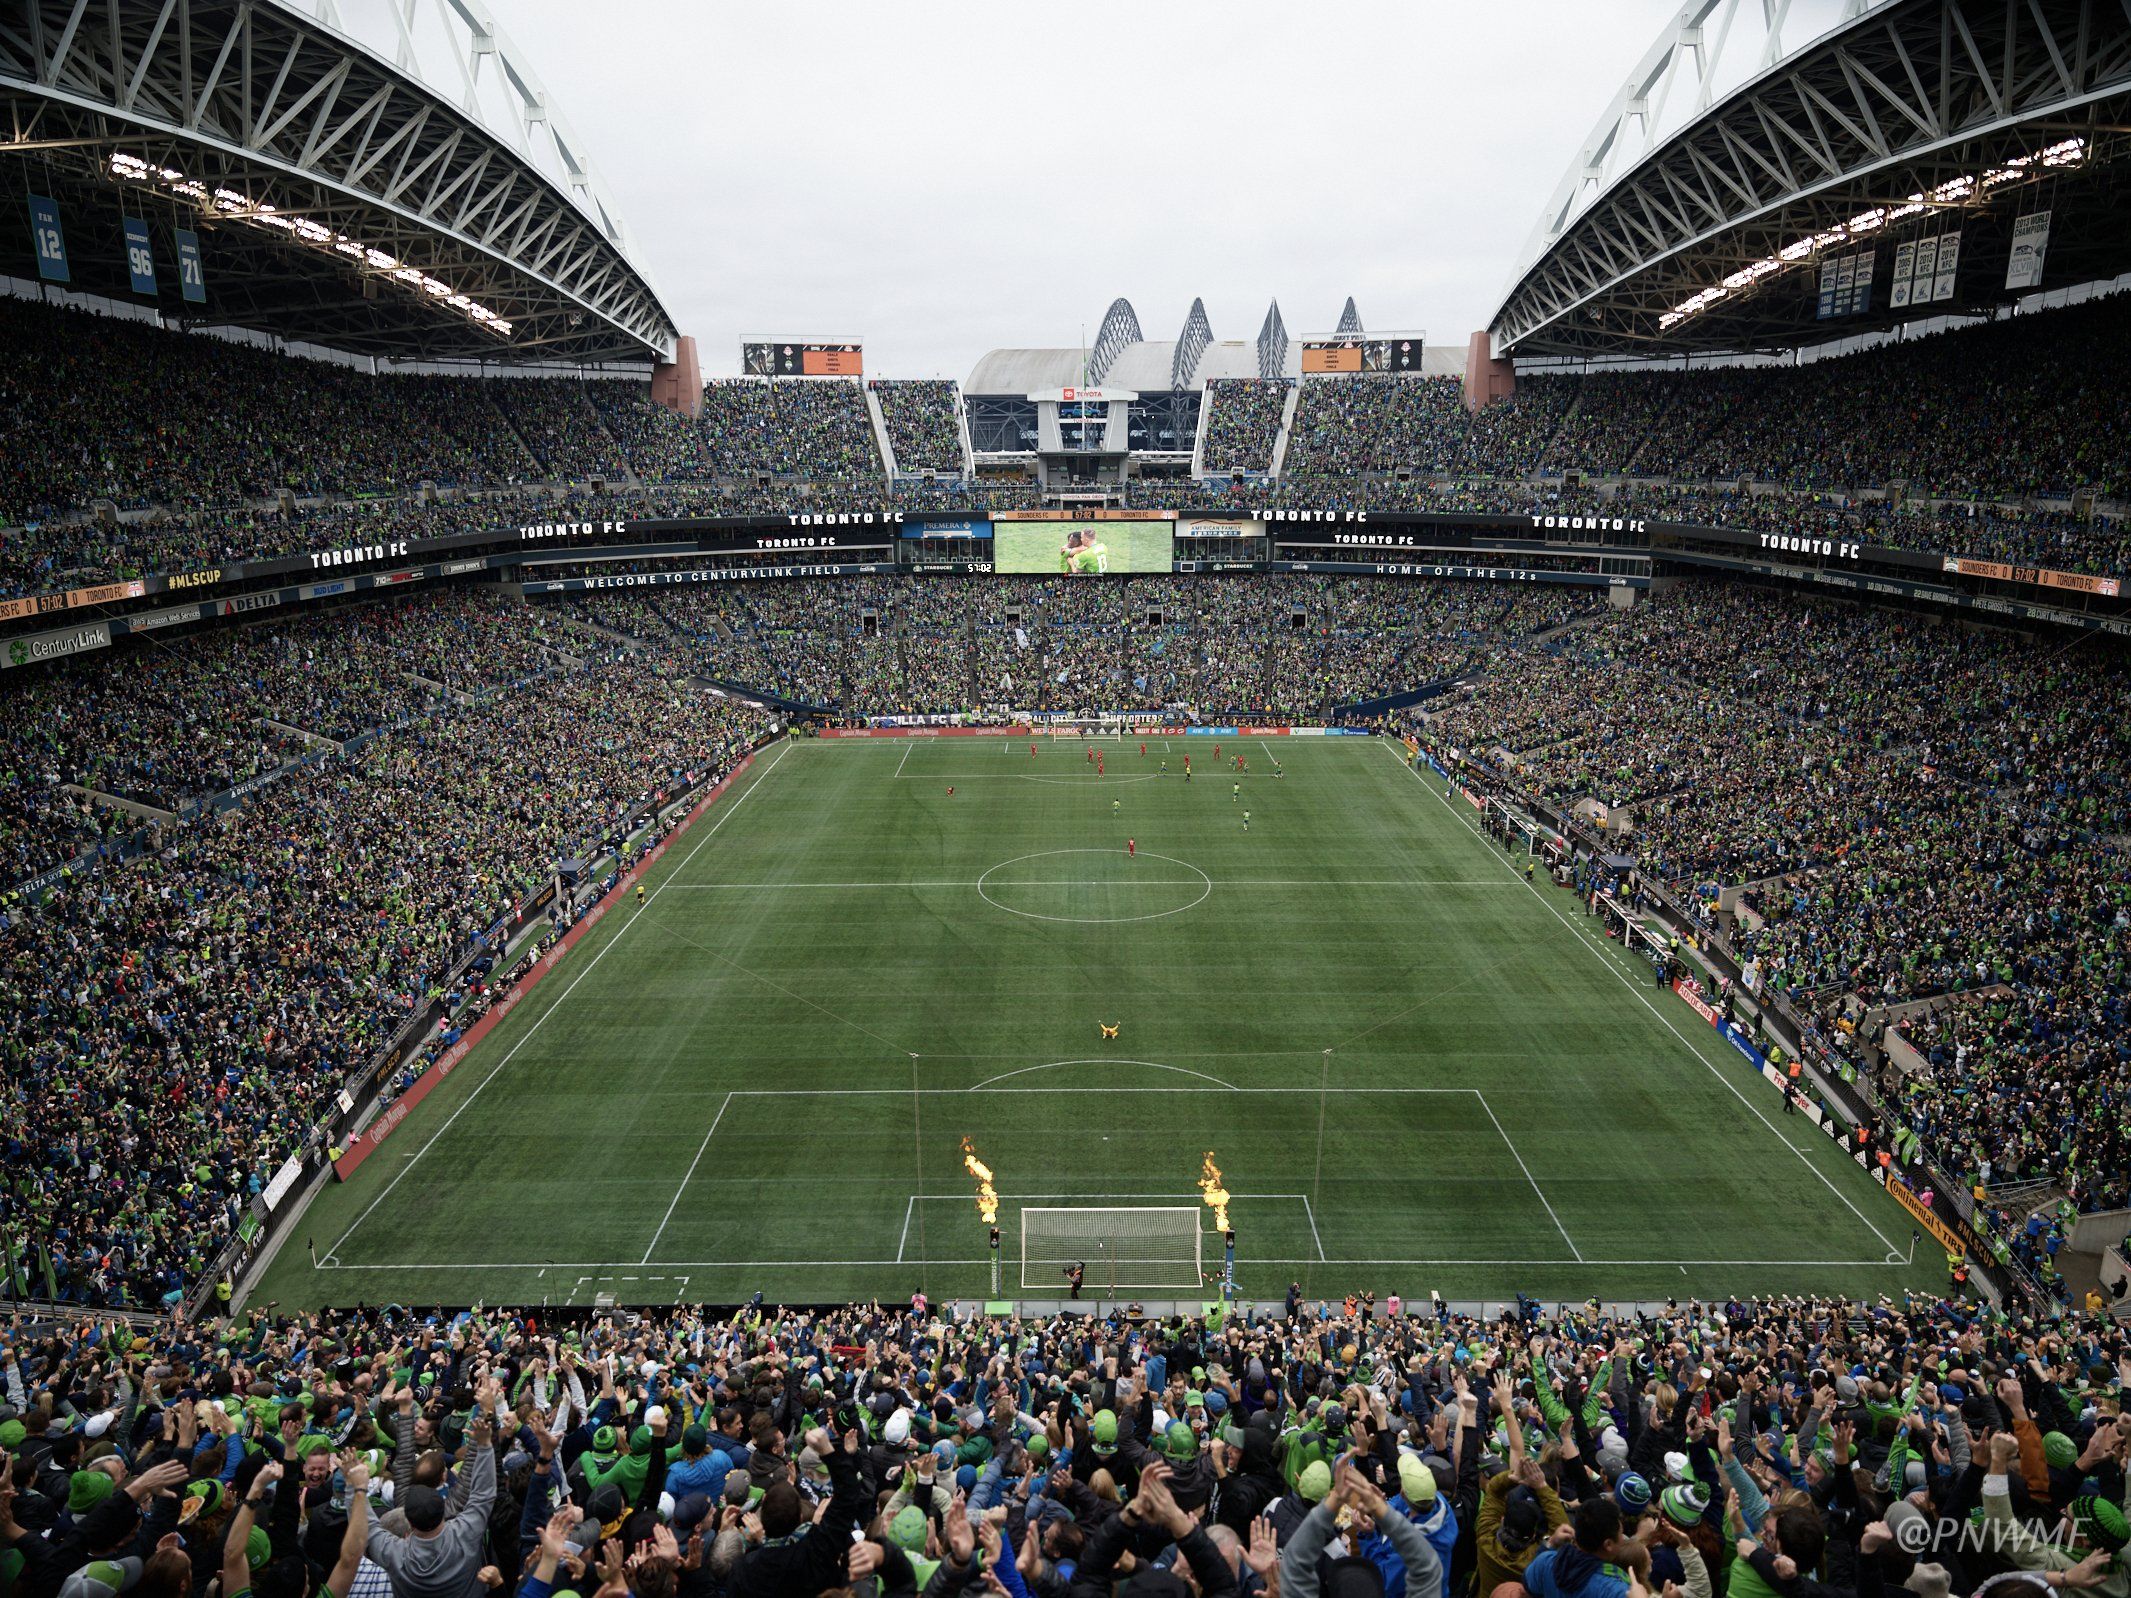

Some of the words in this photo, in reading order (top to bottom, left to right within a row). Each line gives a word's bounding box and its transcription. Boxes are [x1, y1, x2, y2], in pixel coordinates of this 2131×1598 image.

[2014, 222, 2048, 238] CHAMPIONS
[38, 228, 62, 260] 12
[129, 247, 152, 276] 96
[1920, 253, 1932, 264] 2013
[1941, 248, 1956, 260] 2014
[182, 258, 200, 285] 71
[788, 513, 874, 526] TORONTO
[883, 513, 904, 523] FC
[1251, 510, 1336, 522] TORONTO
[1346, 512, 1366, 522] FC
[1532, 516, 1623, 531] TORONTO
[1630, 520, 1645, 532] FC
[520, 523, 593, 540] TORONTO
[603, 522, 626, 534] FC
[756, 538, 814, 548] TORONTO
[821, 537, 835, 546] FC
[1335, 535, 1392, 544] TORONTO
[1399, 536, 1414, 545] FC
[1760, 534, 1832, 555] TORONTO
[1840, 544, 1859, 559] FC
[311, 545, 384, 568] TORONTO
[390, 542, 407, 557] FC
[968, 564, 991, 572] 57:02
[1377, 565, 1422, 575] HOME
[1435, 567, 1454, 576] OF
[1466, 569, 1496, 578] THE
[1510, 571, 1536, 580] 12s
[1962, 561, 1988, 575] SOUNDERS
[1990, 566, 1997, 576] FC
[2003, 566, 2007, 578] 0
[2015, 568, 2035, 582] 57:02
[168, 570, 221, 590] #MLSCUP
[375, 576, 386, 585] 710
[584, 575, 656, 588] WELCOME
[664, 574, 682, 583] TO
[691, 568, 793, 582] CENTURYLINK
[801, 566, 841, 576] FIELD
[2044, 573, 2048, 583] 0
[2057, 574, 2084, 588] TORONTO
[2085, 578, 2093, 590] FC
[86, 588, 114, 602] TORONTO
[114, 586, 122, 598] FC
[313, 585, 326, 596] BUD
[327, 584, 344, 594] LIGHT
[41, 595, 63, 611] 57:02
[72, 592, 78, 605] 0
[237, 594, 276, 611] DELTA
[11, 602, 20, 616] FC
[26, 600, 32, 614] 0
[2027, 608, 2036, 618] 28
[146, 616, 167, 626] Amazon
[168, 613, 180, 622] Web
[181, 611, 200, 620] Services
[32, 630, 104, 657] CenturyLink
[931, 715, 947, 724] FC
[70, 860, 85, 871] CLUB
[1680, 986, 1712, 1019] ADVOCARE
[438, 1053, 455, 1075] Captain
[451, 1041, 470, 1060] Morgan
[1737, 1042, 1754, 1062] Franciscan
[376, 1050, 400, 1081] #MLSCUP
[1820, 1060, 1831, 1074] CUP
[1774, 1072, 1785, 1088] Fre
[370, 1118, 390, 1144] Captain
[387, 1103, 408, 1130] Morgan
[1890, 1179, 1934, 1228] Continental
[233, 1250, 248, 1276] MLS
[253, 1226, 264, 1248] CUP
[1958, 1221, 1995, 1268] #MLSCUP
